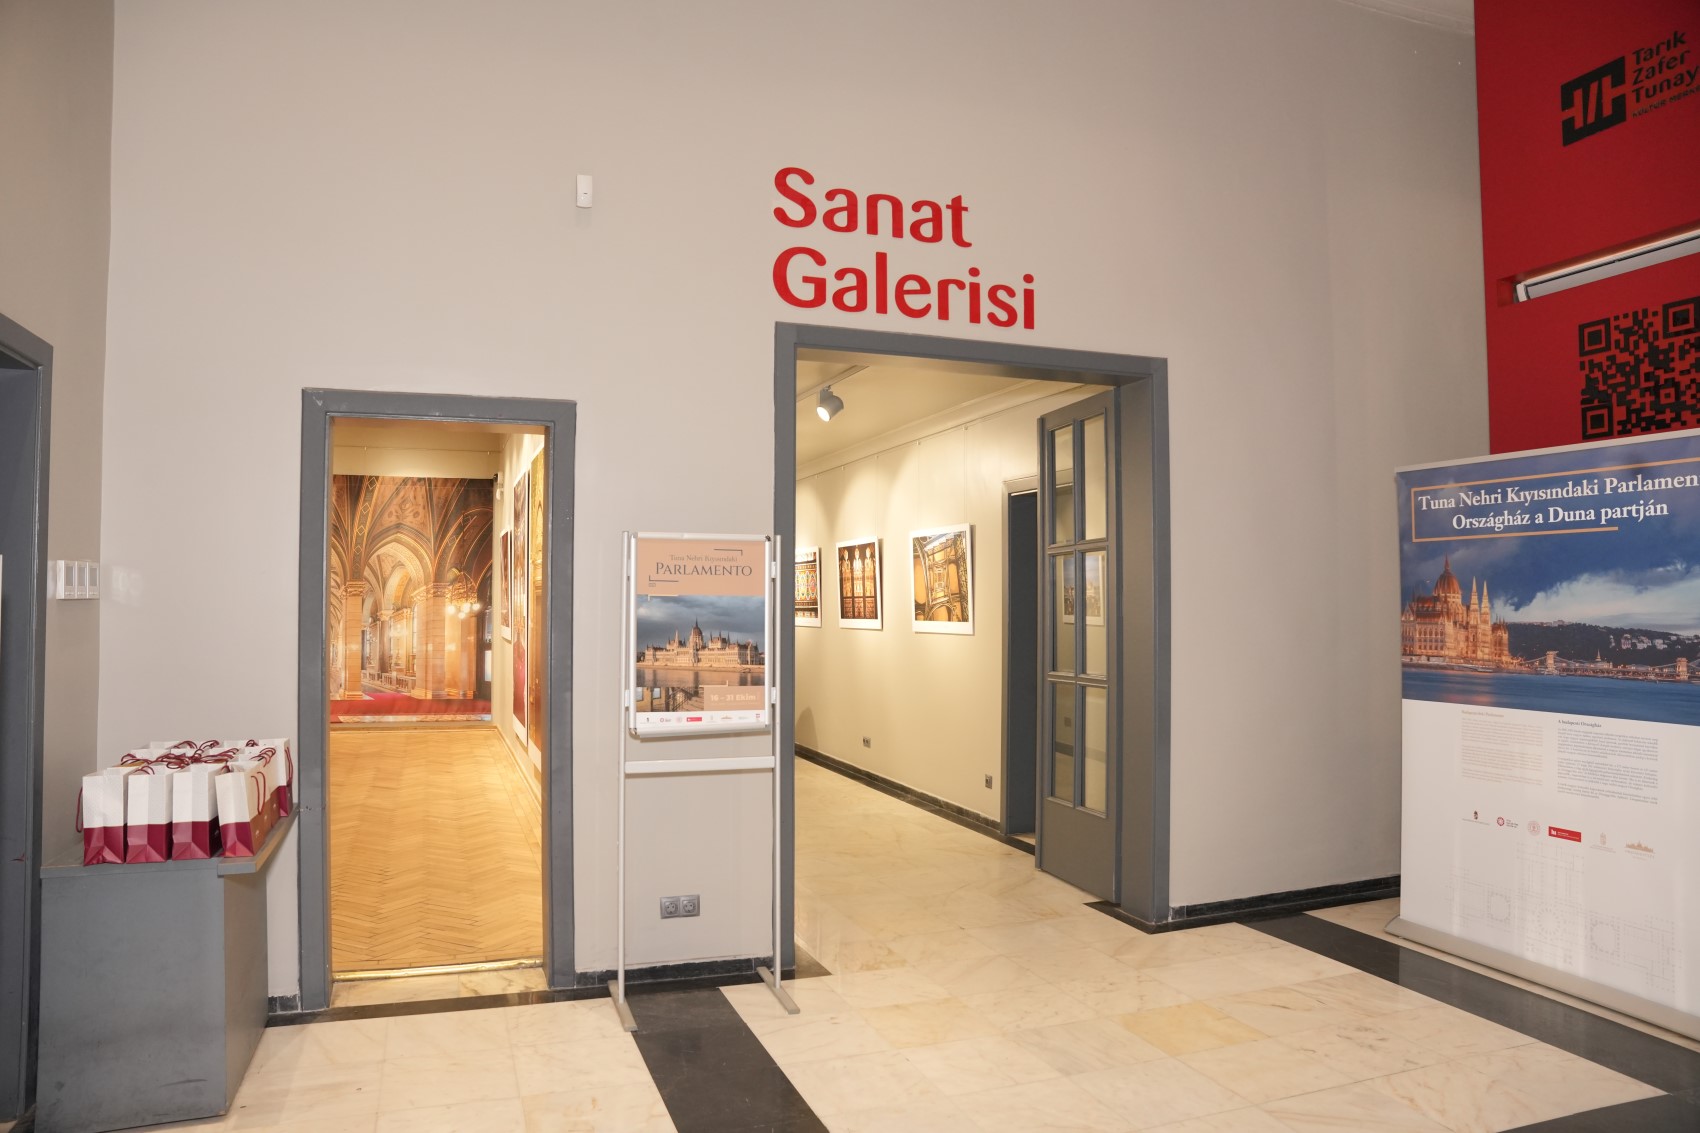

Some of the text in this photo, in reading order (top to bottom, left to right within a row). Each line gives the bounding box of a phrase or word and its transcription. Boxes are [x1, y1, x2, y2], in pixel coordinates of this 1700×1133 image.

[1632, 31, 1686, 65] Tarık
[1632, 50, 1691, 86] Zafer
[773, 167, 972, 248] Sanat
[772, 246, 1035, 330] Galerisi
[1418, 474, 1700, 511] Tuna Nehri Kıyısındaki Parlamen
[1452, 499, 1669, 532] Országház a Duna partján
[656, 561, 753, 577] PARLAMENTO
[736, 693, 757, 702] Ekim
